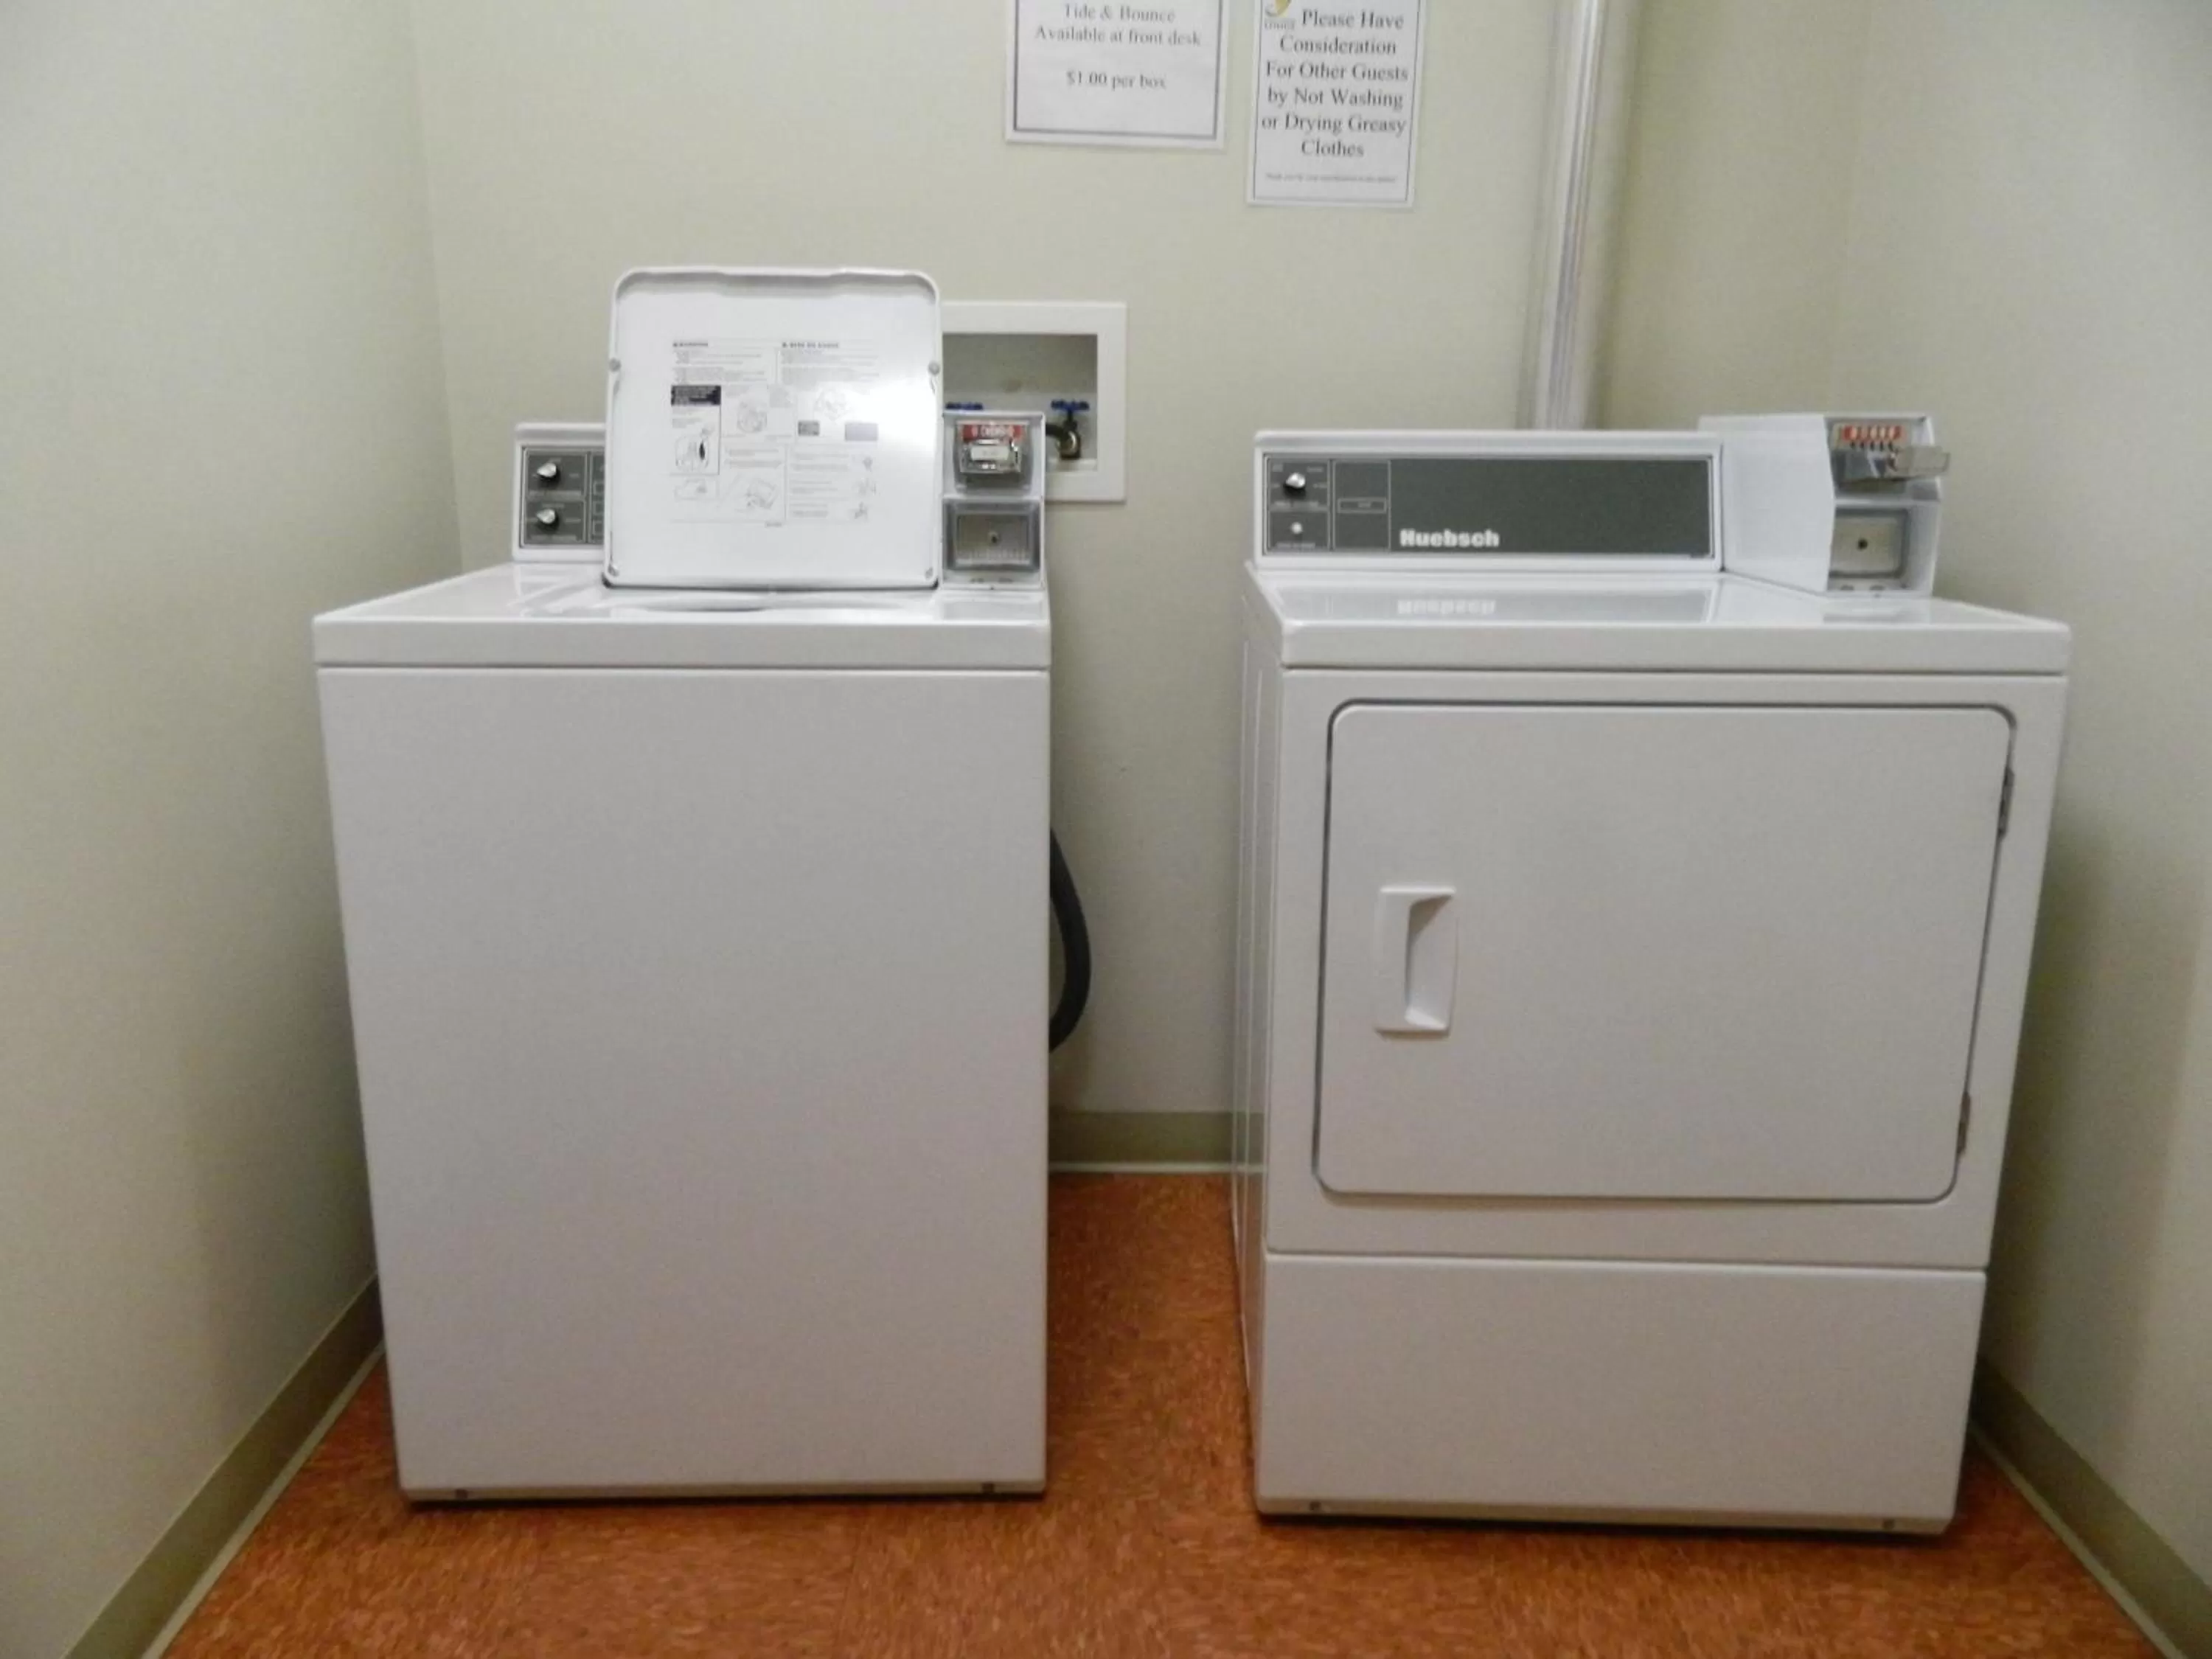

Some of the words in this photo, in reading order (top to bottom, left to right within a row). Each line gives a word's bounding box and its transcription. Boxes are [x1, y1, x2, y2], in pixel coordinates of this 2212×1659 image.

[1065, 4, 1096, 19] Tide
[1100, 5, 1112, 20] &
[1119, 4, 1175, 23] Bounce
[1302, 9, 1354, 28] Please
[1361, 10, 1405, 29] Have
[1035, 24, 1105, 42] Available
[1110, 29, 1123, 44] at
[1129, 28, 1163, 45] front
[1168, 29, 1201, 46] desk
[1279, 35, 1397, 55] Consideration
[1066, 69, 1107, 86] $1.00
[1111, 75, 1135, 91] per
[1139, 74, 1166, 89] box
[1267, 60, 1294, 78] For
[1299, 61, 1346, 80] Other
[1352, 63, 1408, 81] Guests
[1267, 86, 1289, 108] by
[1295, 87, 1324, 105] Not
[1331, 88, 1403, 112] Washing
[1262, 116, 1279, 131] or
[1285, 112, 1342, 136] Drying
[1348, 114, 1408, 138] Greasy
[1301, 137, 1364, 157] Clothes
[1400, 528, 1500, 547] Huebsch
